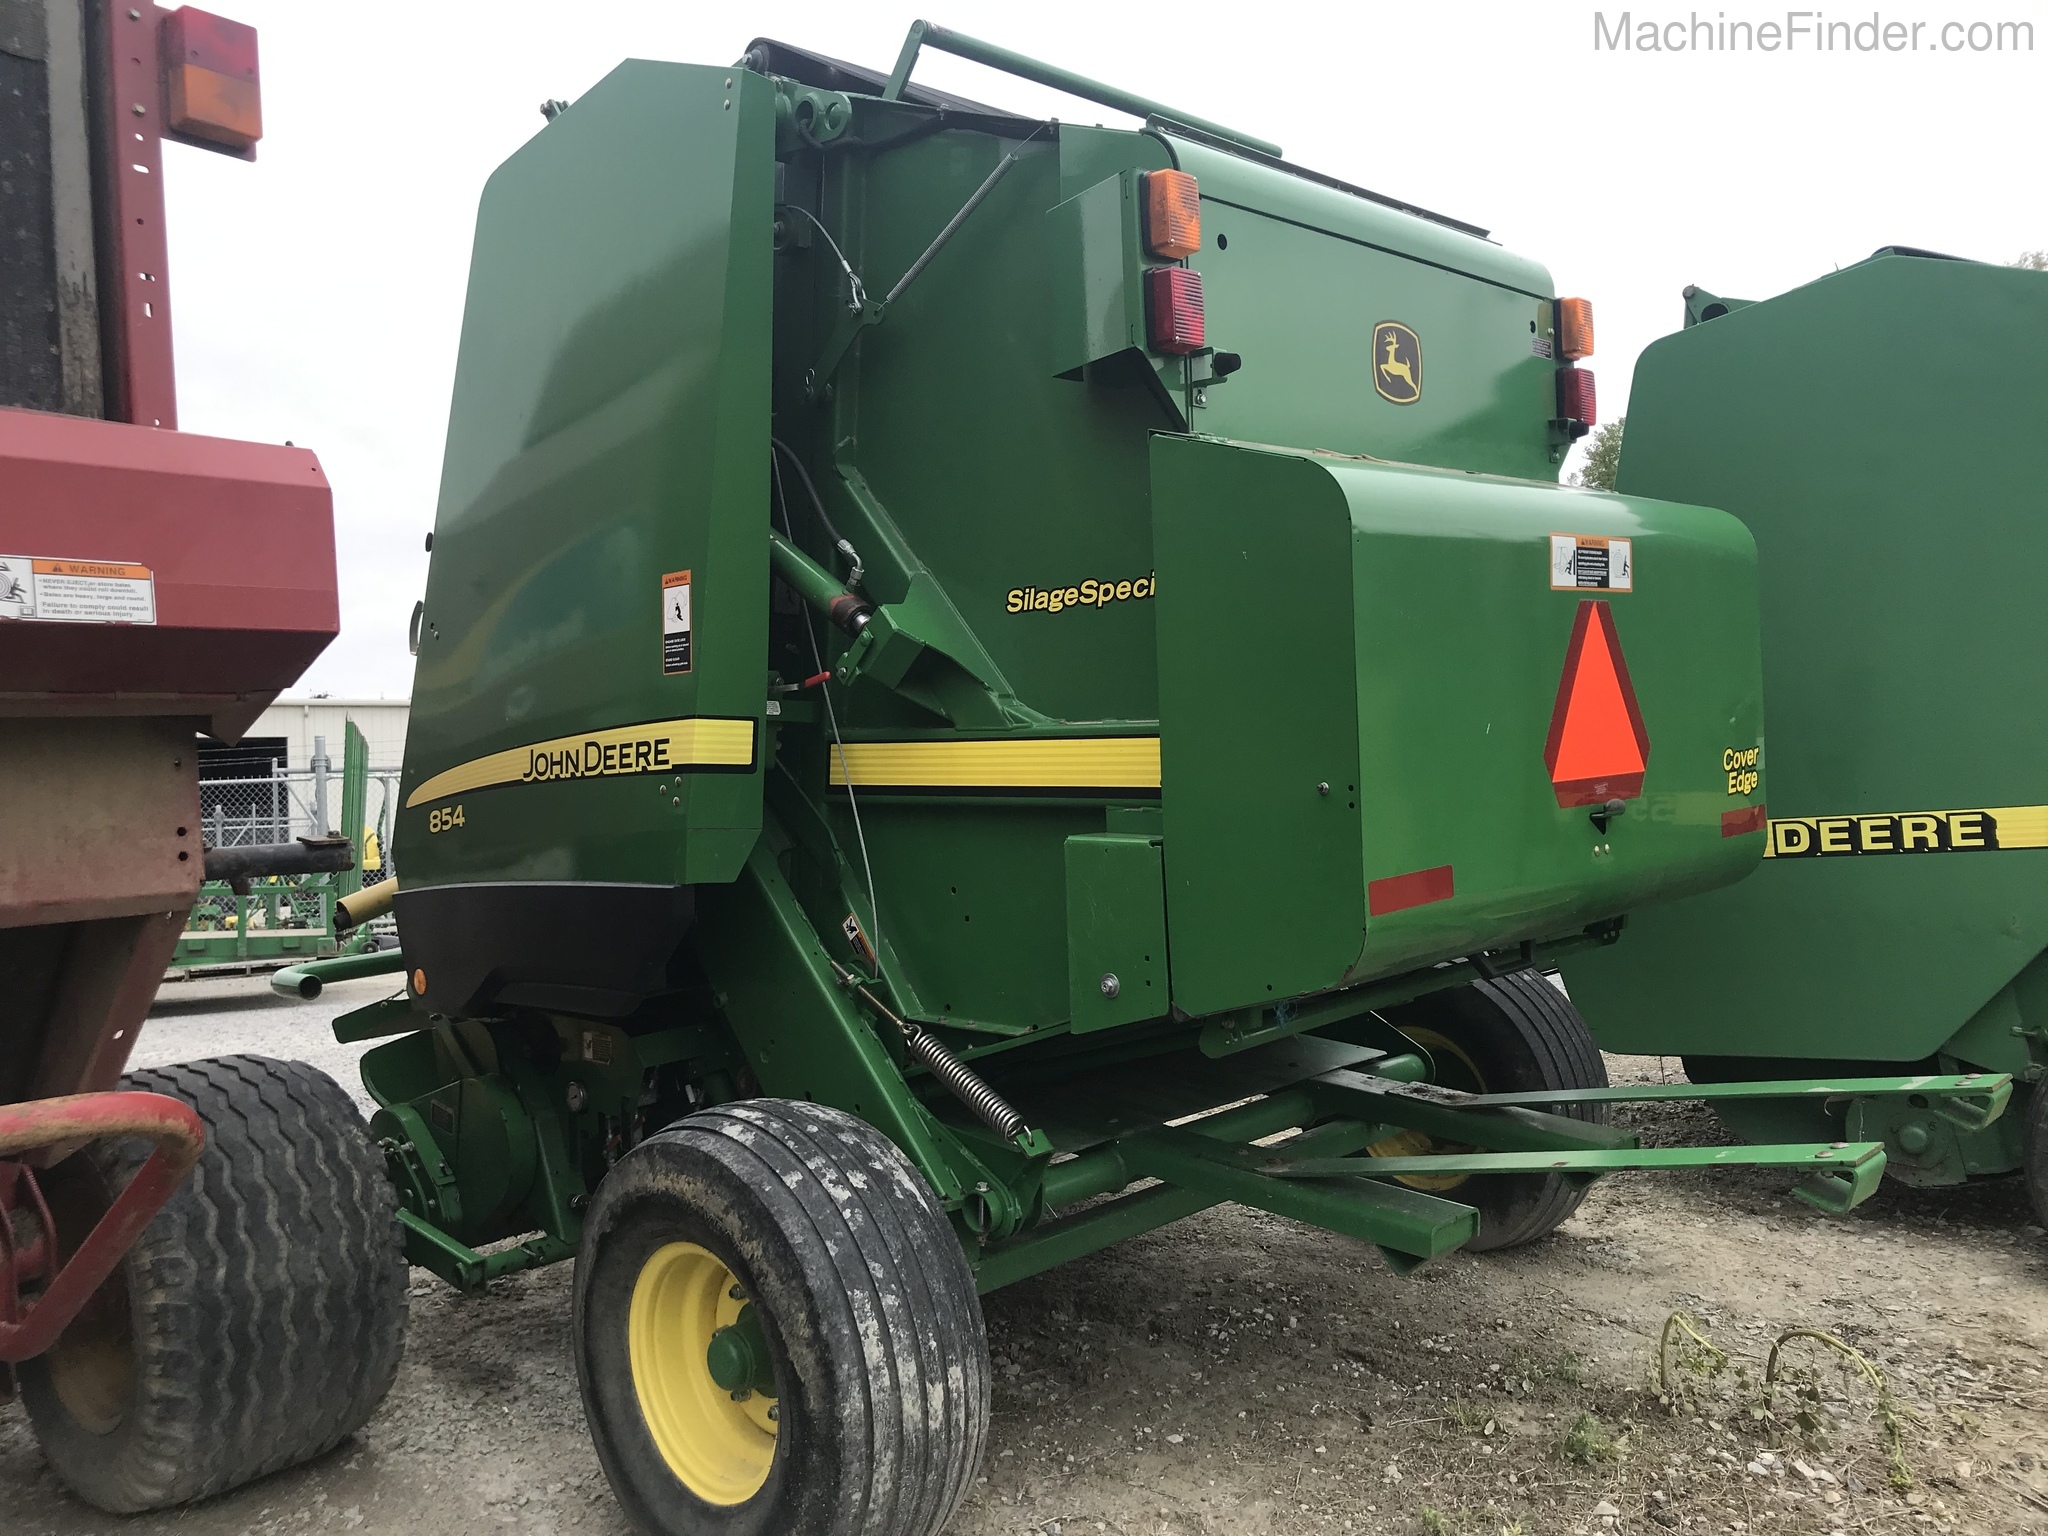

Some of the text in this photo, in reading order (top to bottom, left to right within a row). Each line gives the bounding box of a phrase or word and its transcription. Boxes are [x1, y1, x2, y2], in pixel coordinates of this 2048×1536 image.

[69, 564, 126, 576] WARNING
[1005, 570, 1155, 614] SilageSpeci
[80, 604, 106, 613] comply
[522, 738, 673, 781] JOHN DEERE
[1722, 747, 1759, 772] Cover
[1728, 769, 1758, 795] Edge
[429, 805, 466, 833] 854
[1774, 813, 1990, 855] DEERE
